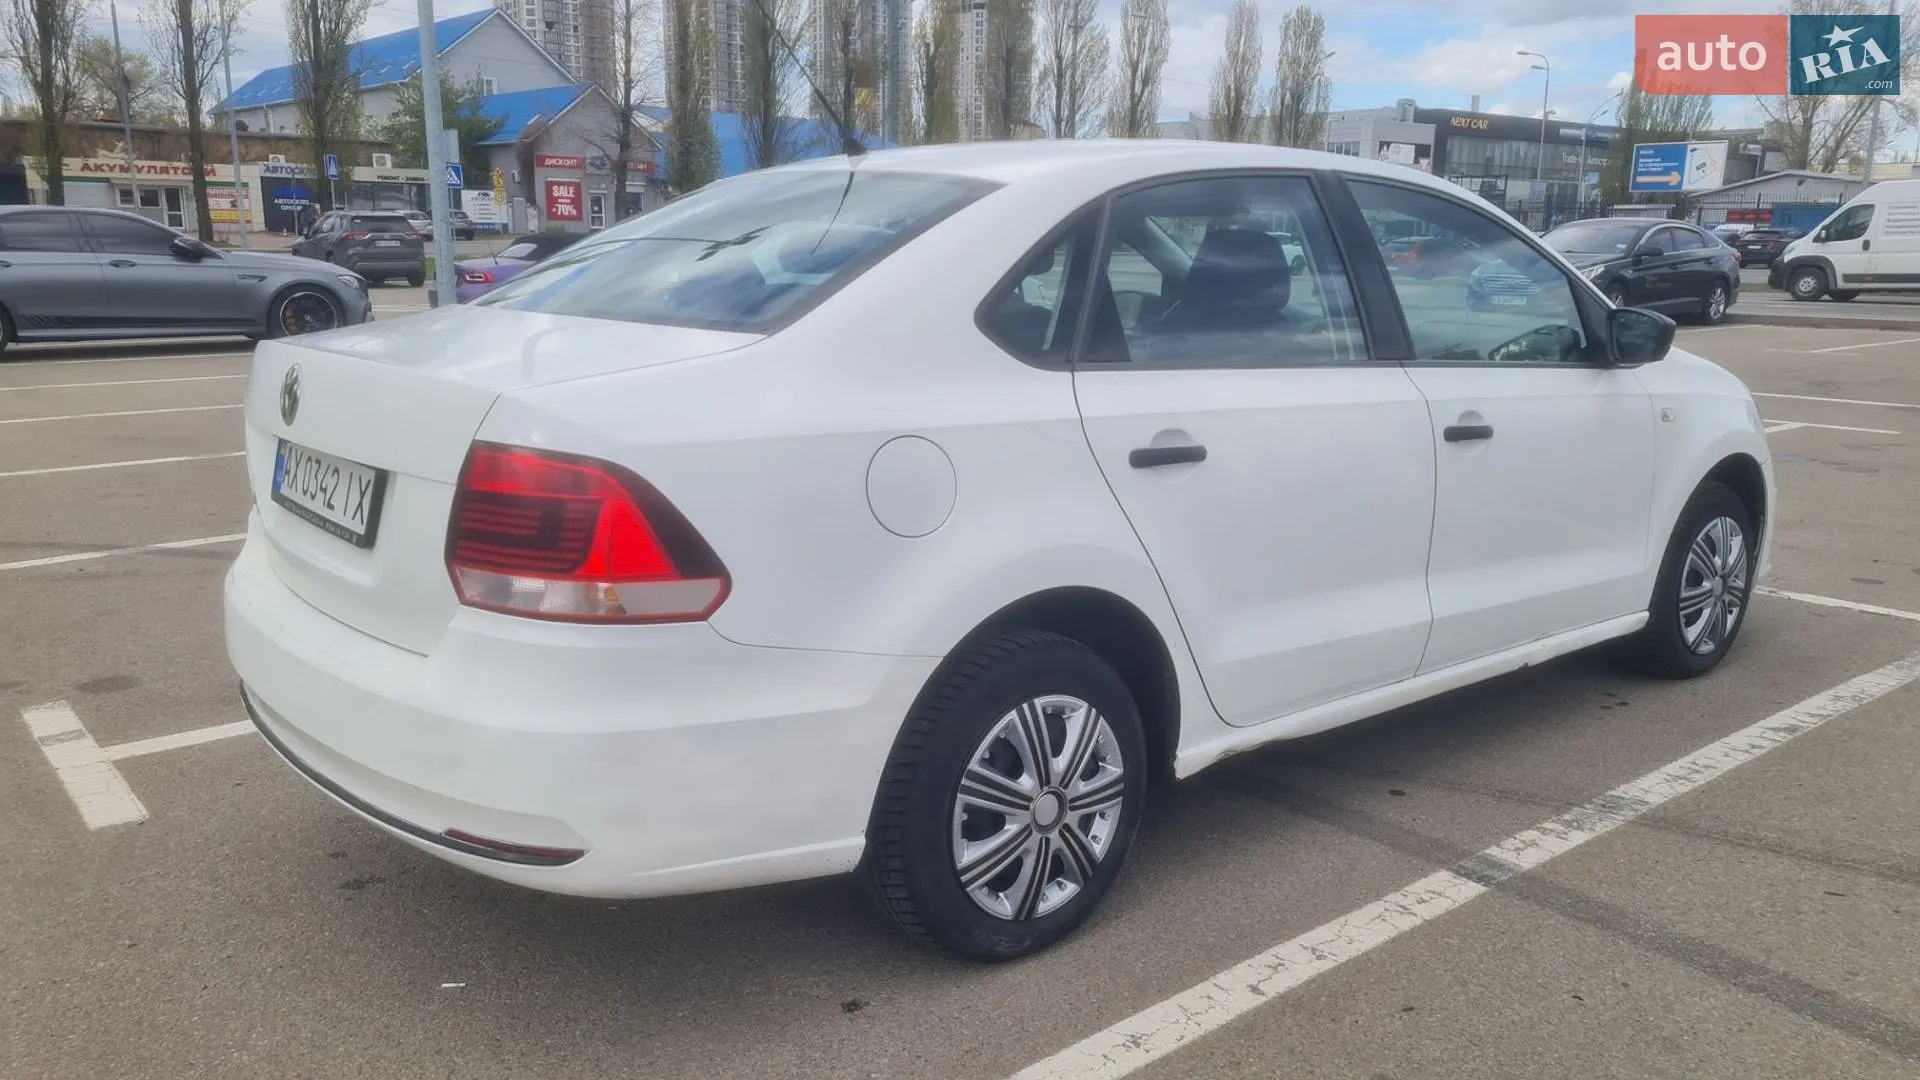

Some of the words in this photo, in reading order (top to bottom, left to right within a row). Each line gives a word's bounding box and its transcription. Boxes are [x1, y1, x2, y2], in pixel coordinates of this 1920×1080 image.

[1471, 119, 1489, 130] CAR
[552, 185, 575, 198] SALE
[552, 204, 577, 217] -70%
[302, 454, 341, 512] 0342
[344, 471, 372, 525] IX
